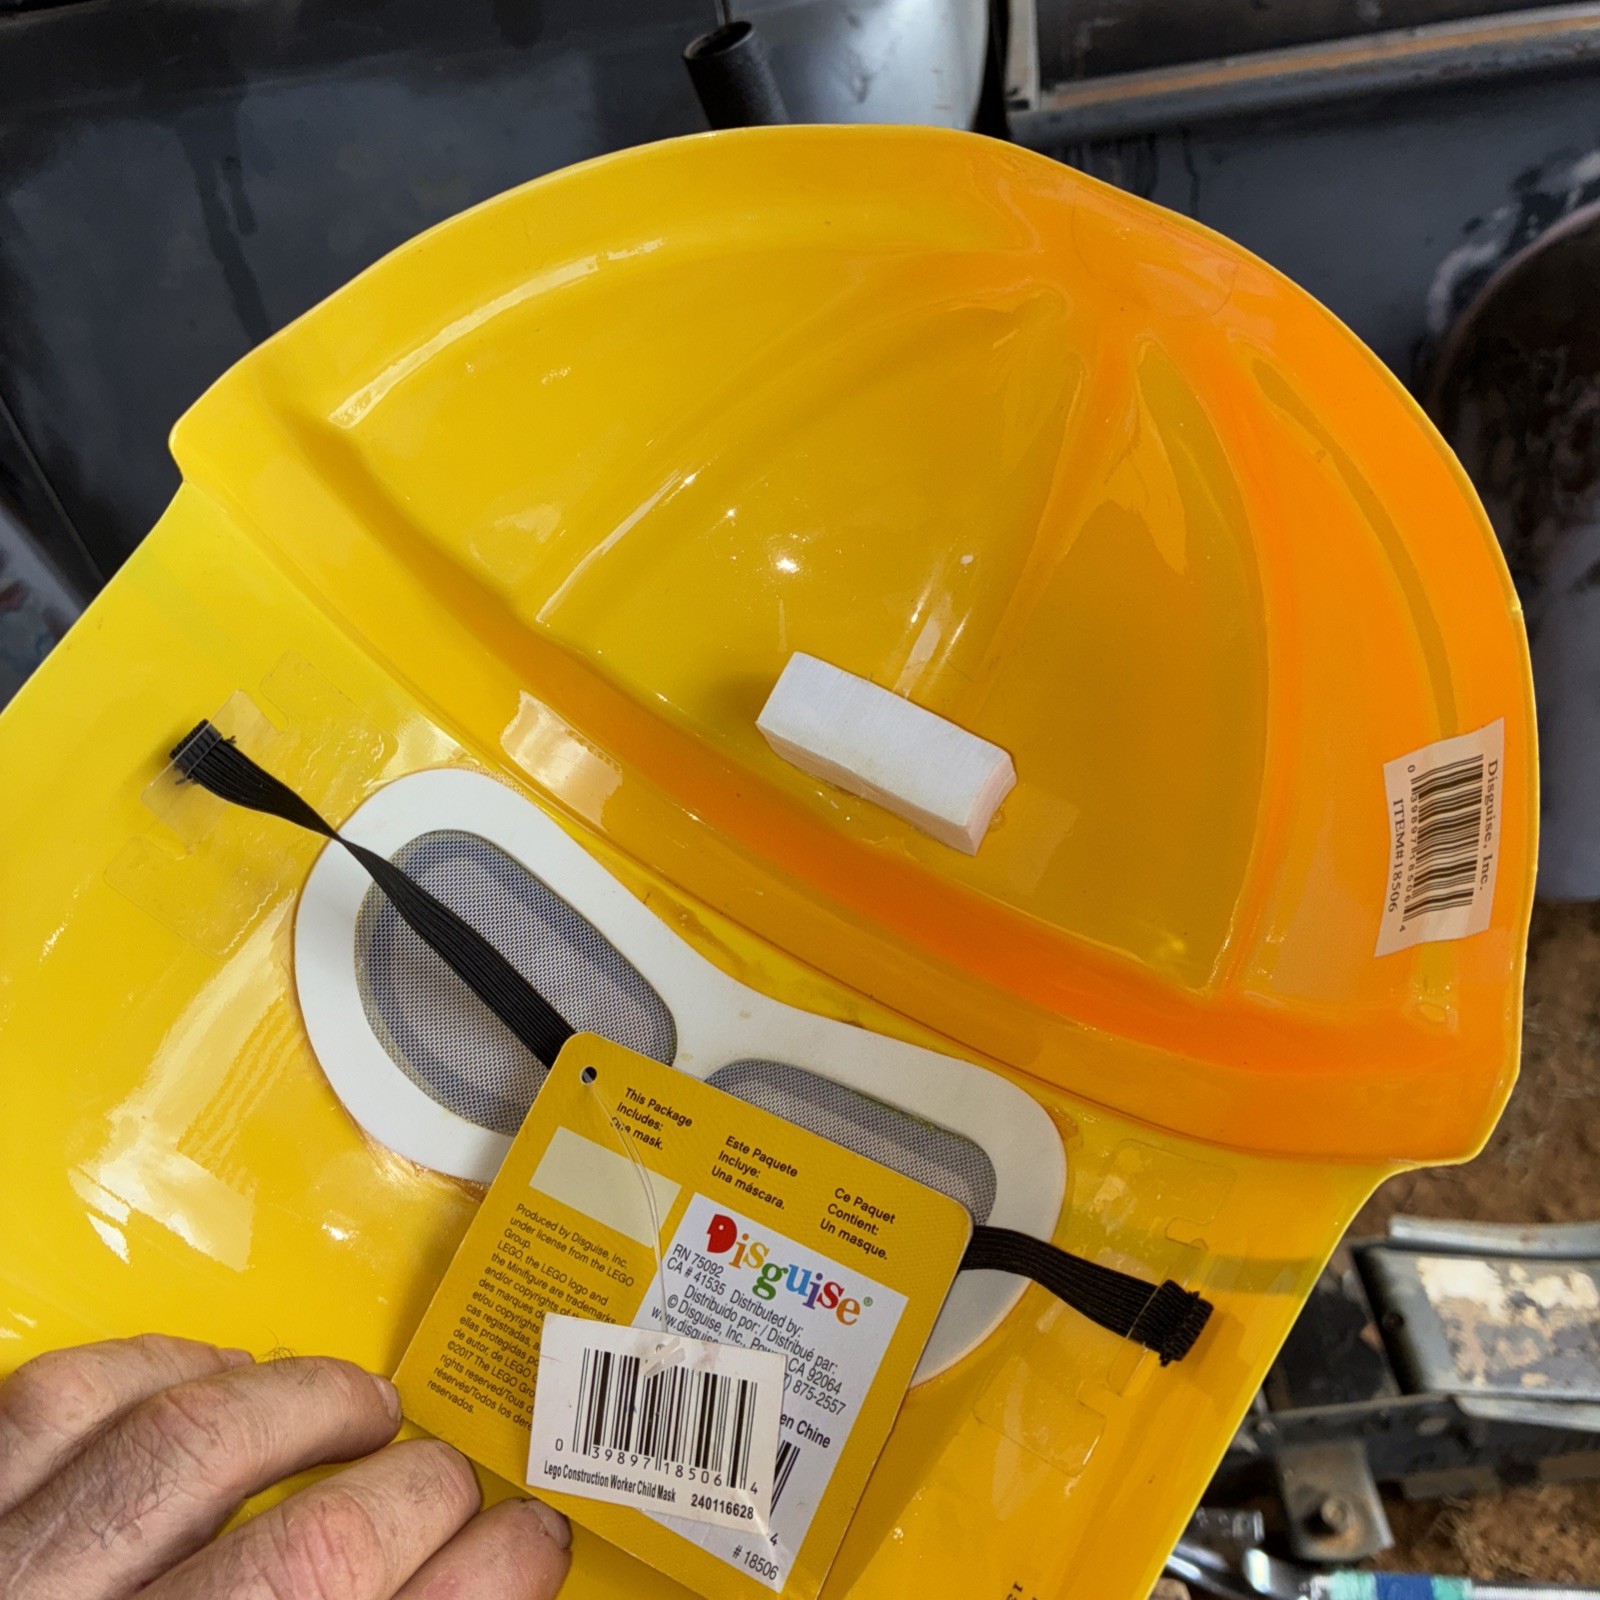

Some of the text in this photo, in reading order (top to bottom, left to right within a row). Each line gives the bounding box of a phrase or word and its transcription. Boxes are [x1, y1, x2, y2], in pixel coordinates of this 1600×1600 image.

[1407, 764, 1416, 773] 0
[1479, 758, 1499, 891] Disguise, Inc.
[1388, 798, 1404, 913] ITEM#18506
[1404, 853, 1417, 903] 18506
[616, 1101, 664, 1131] Includes:
[625, 1087, 693, 1127] This Package
[633, 1129, 663, 1150] mask.
[725, 1135, 798, 1178] Este Paquete
[718, 1151, 760, 1179] Incluye:
[711, 1166, 786, 1210] Una máscara.
[834, 1188, 896, 1225] Ce Paquet
[504, 1228, 531, 1249] Group.
[516, 1203, 559, 1232] Produced
[558, 1226, 570, 1239] by
[571, 1232, 609, 1260] Disguise,
[820, 1218, 888, 1261] Un masque.
[827, 1203, 879, 1236] Contient:
[497, 1240, 609, 1306] LEGO, the LEGO logo and
[510, 1217, 634, 1287] under license from the LEGO
[672, 1243, 724, 1279] RN 75092
[479, 1278, 495, 1292] des
[496, 1288, 534, 1314] marques
[484, 1266, 512, 1287] and/or
[513, 1281, 559, 1312] copyrights
[491, 1252, 617, 1324] the Minifigure are trademarks
[667, 1257, 804, 1339] CA # 41535 Distributed by:
[466, 1304, 481, 1317] cas
[483, 1313, 531, 1347] registradas,
[472, 1291, 541, 1334] et/ou copyrights
[684, 1284, 738, 1322] Distribuido
[737, 1315, 761, 1336] por:
[767, 1327, 815, 1362] Distribué
[813, 1355, 838, 1375] par:
[453, 1329, 531, 1378] de autor, de LEGO
[460, 1316, 480, 1332] ellas
[480, 1328, 527, 1359] protegidas
[678, 1300, 722, 1336] Disguise,
[788, 1358, 806, 1377] CA
[807, 1368, 842, 1396] 92064
[440, 1354, 525, 1409] rights reserved/Tous
[447, 1340, 474, 1360] ©2017
[474, 1356, 490, 1371] The
[491, 1366, 518, 1387] LEGO
[519, 1382, 536, 1398] Gro
[427, 1380, 474, 1414] reservados.
[433, 1367, 497, 1410] réservés/Todos
[498, 1403, 512, 1418] los
[793, 1380, 847, 1415] 875-2557
[797, 1420, 831, 1448] Chine
[544, 1460, 676, 1503] Lego Construction Worker Child Mask
[555, 1438, 758, 1495] 0 39897 18506 4
[691, 1494, 754, 1520] 240116628
[769, 1532, 779, 1546] 4
[733, 1545, 779, 1581] # 18506
